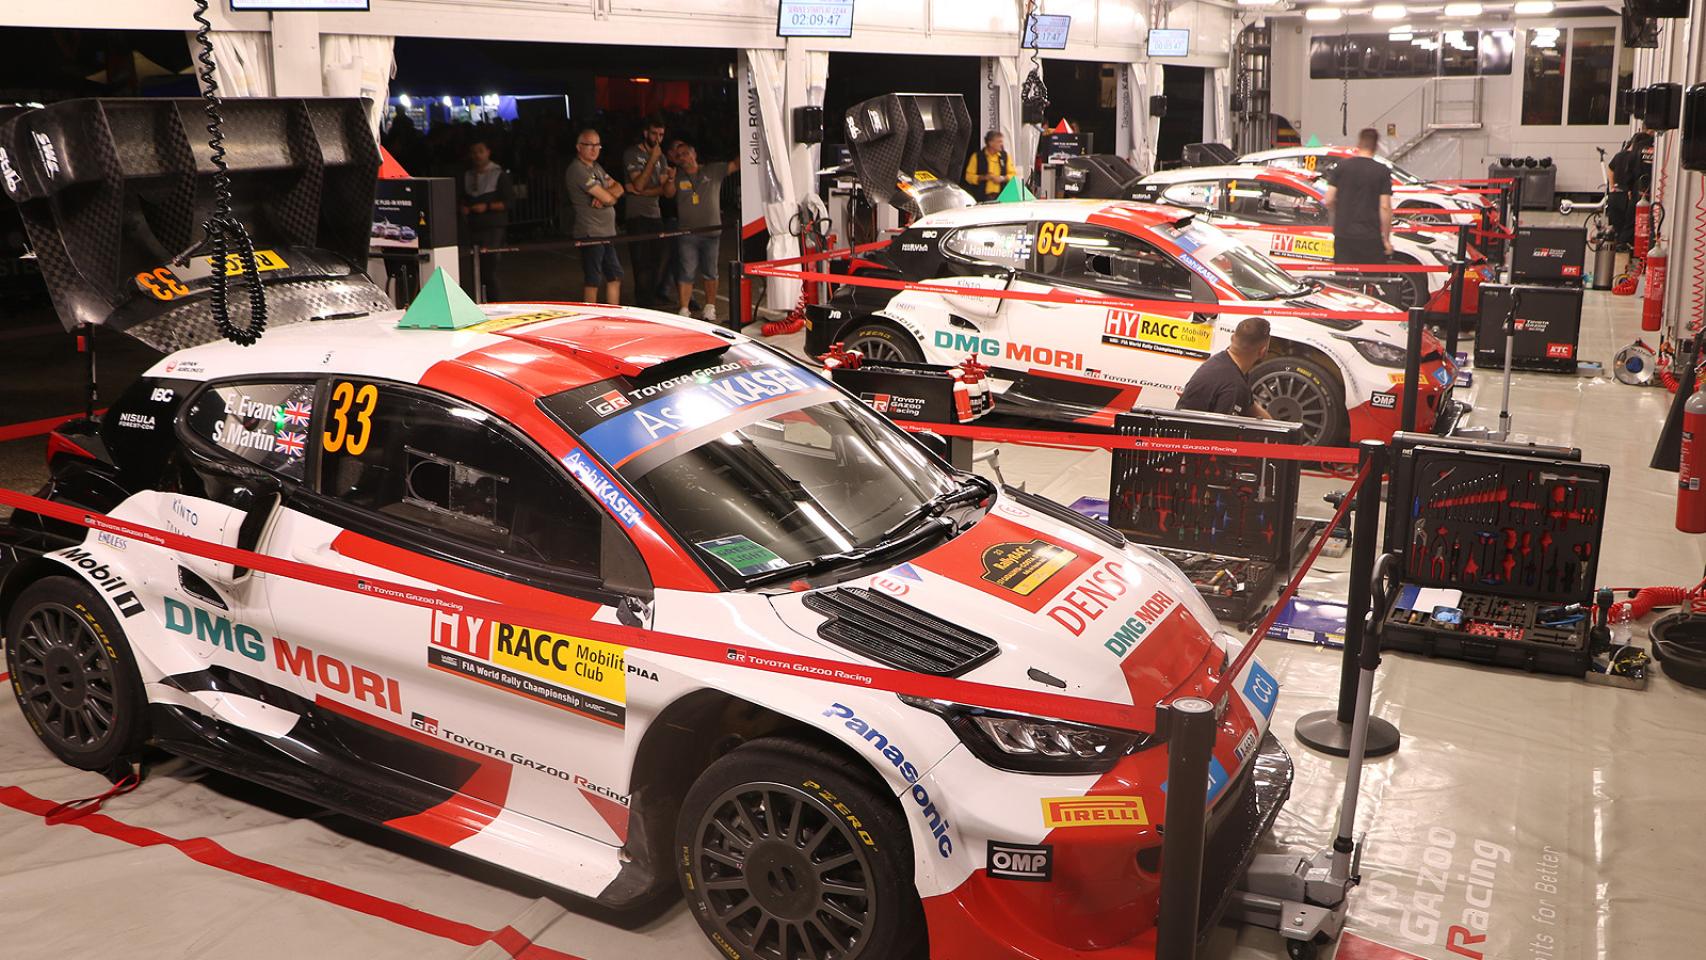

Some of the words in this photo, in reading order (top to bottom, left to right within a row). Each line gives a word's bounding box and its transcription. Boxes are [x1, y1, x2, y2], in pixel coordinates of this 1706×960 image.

[792, 14, 841, 25] 02:09:47
[750, 130, 761, 165] Kalle
[1303, 155, 1316, 171] 18
[1037, 222, 1069, 256] 69
[1273, 234, 1293, 251] HY
[1295, 238, 1320, 251] RACC
[136, 267, 189, 301] 33
[1105, 309, 1138, 337] HY
[1141, 320, 1179, 339] RACC
[1182, 326, 1209, 339] Mobility
[1181, 335, 1196, 343] Club
[935, 330, 1000, 357] DMG
[1006, 342, 1083, 371] MORI
[596, 396, 632, 416] GR
[628, 375, 693, 400] TOYOTA
[692, 362, 740, 386] GAZOO
[1102, 374, 1138, 384] TOYOTA
[1140, 379, 1172, 389] GAZOO
[224, 393, 283, 422] E.Evans
[889, 407, 920, 416] Racing
[891, 395, 926, 405] TOYOTA
[1373, 394, 1396, 407] OMP
[120, 412, 156, 425] NISULA
[322, 381, 379, 456] 33
[212, 419, 275, 453] S.Martin
[564, 451, 642, 525] AsahiKASEI
[98, 531, 128, 551] ENDLESS
[144, 532, 165, 544] Racing
[60, 548, 127, 593] Mobil
[373, 586, 404, 598] TOYOTA
[405, 592, 435, 605] GAZOO
[435, 598, 463, 612] Racing
[1104, 616, 1147, 658] DMG
[1134, 590, 1175, 626] MORI
[163, 596, 267, 662] DMG
[272, 637, 403, 715] MORI
[433, 609, 484, 653] HY
[497, 622, 570, 672] RACC
[576, 644, 626, 676] Mobilit
[462, 661, 476, 673] FIA
[476, 665, 500, 680] World
[501, 673, 522, 688] Rally
[522, 681, 580, 706] Championship
[574, 661, 604, 682] Club
[627, 664, 660, 682] PIAA
[727, 652, 745, 662] GR
[748, 656, 791, 670] TOYOTA
[792, 663, 833, 676] GAZOO
[834, 671, 873, 685] Racing
[412, 720, 438, 736] GR
[443, 729, 506, 759] TOYOTA
[510, 753, 571, 781] GAZOO
[574, 774, 629, 806] Racing
[822, 702, 953, 858] Panasonic
[818, 791, 875, 847] ZERO
[1048, 801, 1139, 823] PIRELLI
[992, 852, 1047, 872] OMP
[1534, 844, 1562, 894] Better
[1400, 825, 1457, 945] GAZOO
[1445, 838, 1512, 960] Racing
[1536, 896, 1556, 927] for
